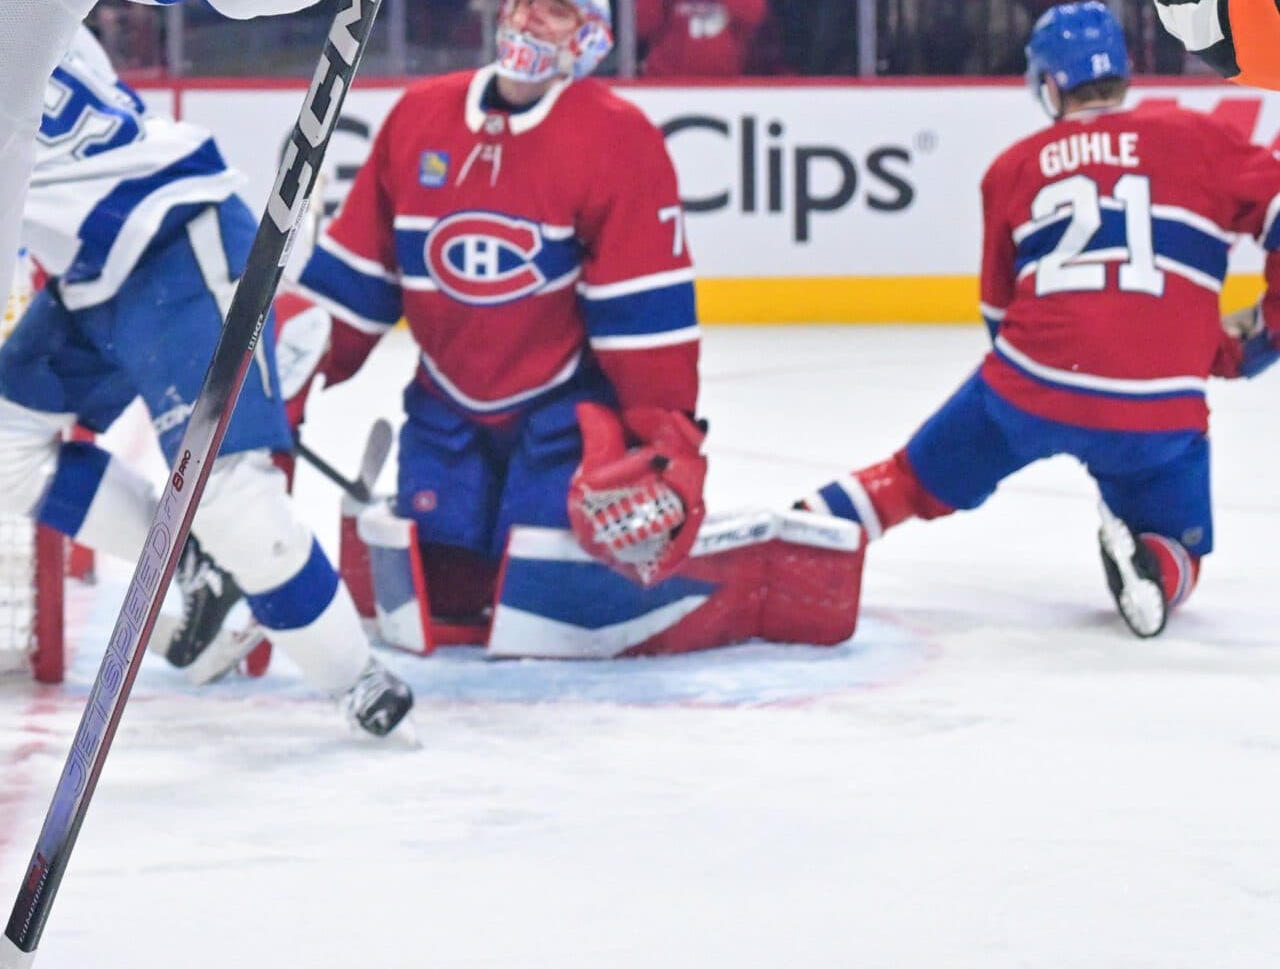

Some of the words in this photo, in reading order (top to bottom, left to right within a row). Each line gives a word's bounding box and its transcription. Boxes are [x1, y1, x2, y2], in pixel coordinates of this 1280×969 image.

[660, 114, 915, 242] Clips
[1038, 132, 1141, 178] GUHLE
[1030, 172, 1166, 299] 21
[64, 522, 171, 795] JETSPEED
